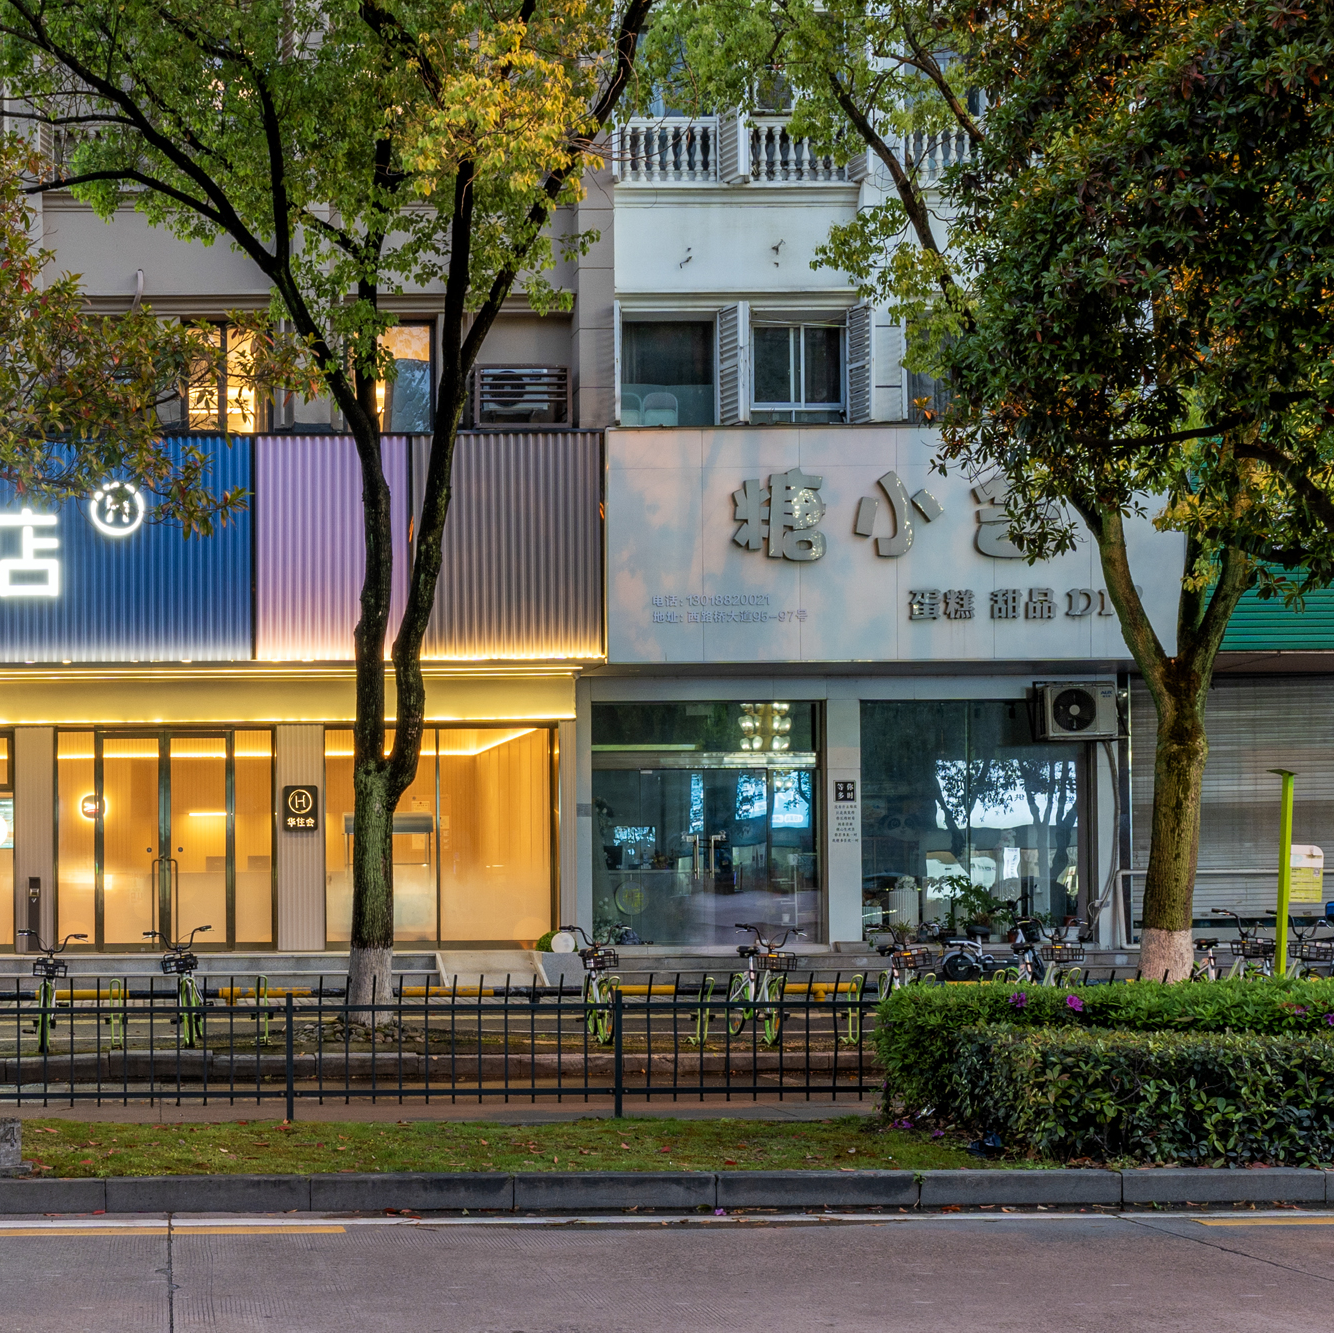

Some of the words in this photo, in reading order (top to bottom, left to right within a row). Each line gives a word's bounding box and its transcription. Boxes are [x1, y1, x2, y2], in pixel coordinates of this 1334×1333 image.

[909, 588, 975, 619] 蛋糕
[990, 587, 1056, 619] 甜品
[287, 817, 315, 827] 华住会
